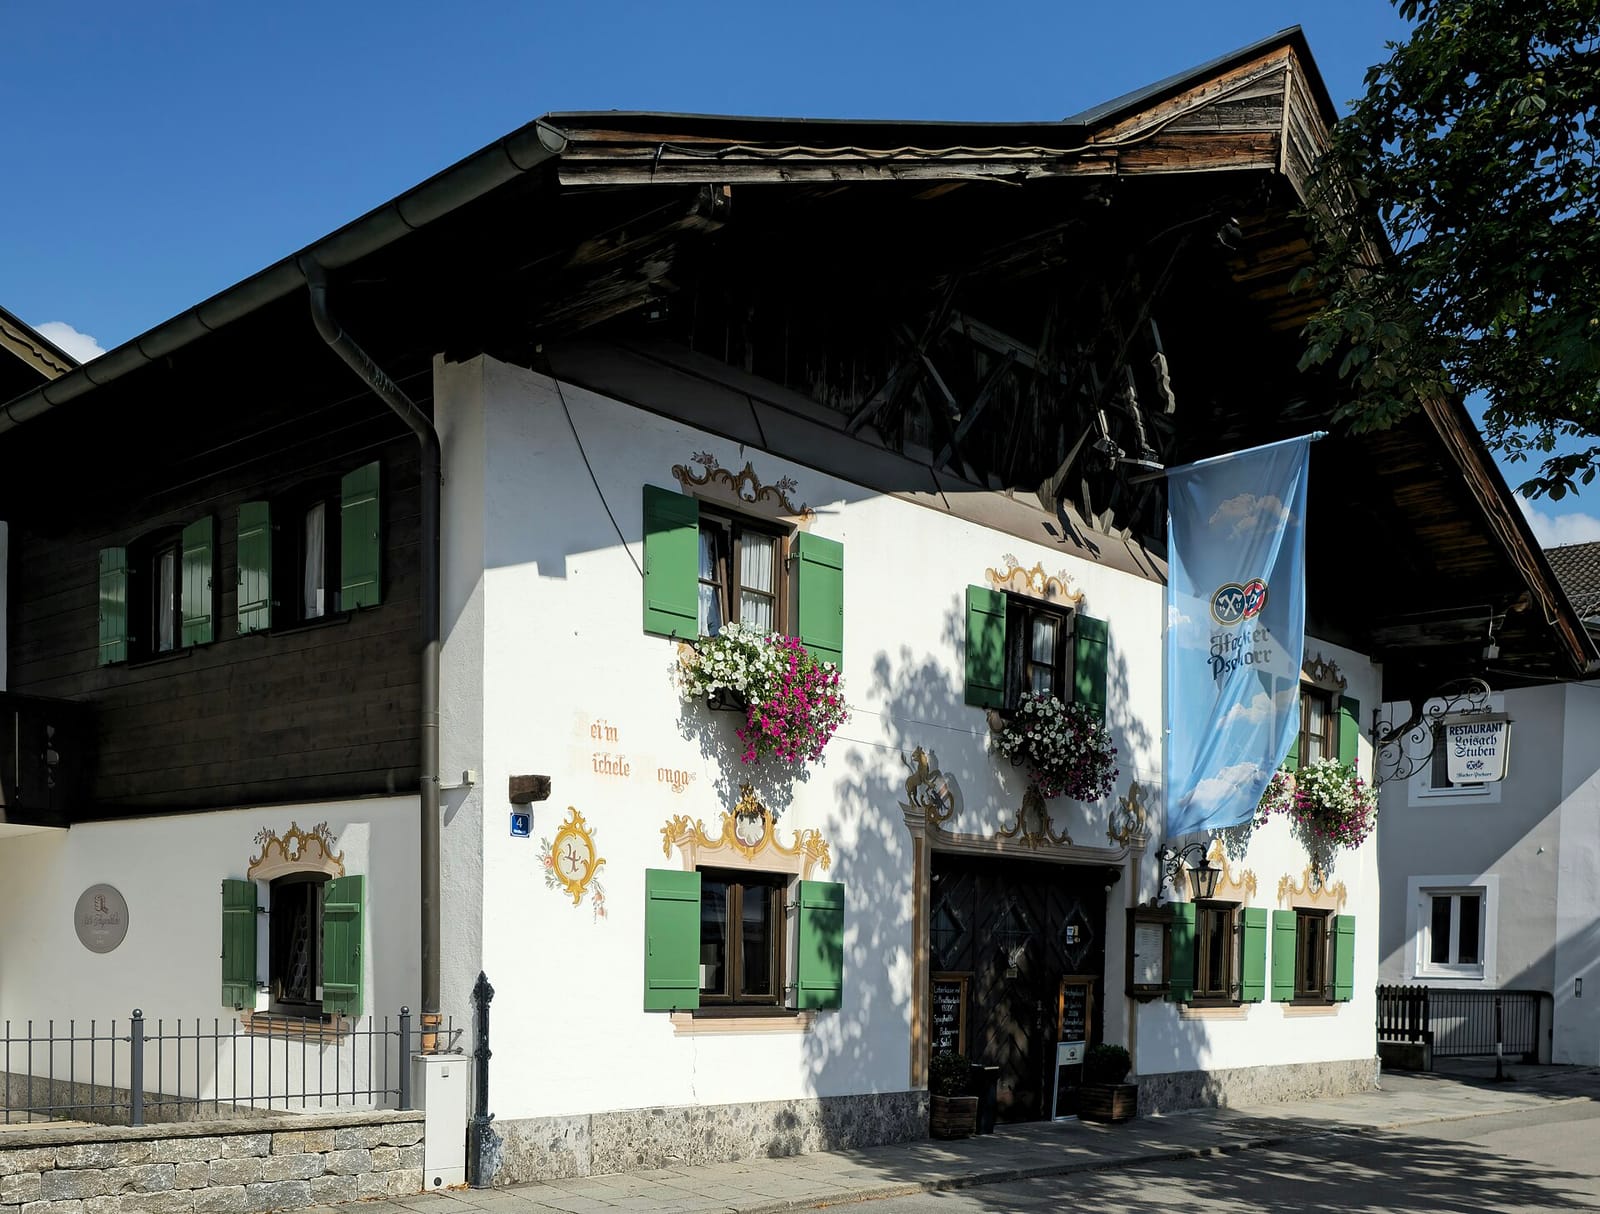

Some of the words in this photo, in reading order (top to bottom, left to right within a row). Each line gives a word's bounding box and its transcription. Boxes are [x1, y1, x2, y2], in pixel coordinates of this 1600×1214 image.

[1449, 722, 1503, 736] RESTAURANT
[1455, 734, 1497, 747] Loisach
[1454, 746, 1496, 758] Stuben
[516, 817, 524, 829] 4
[564, 843, 582, 872] 4
